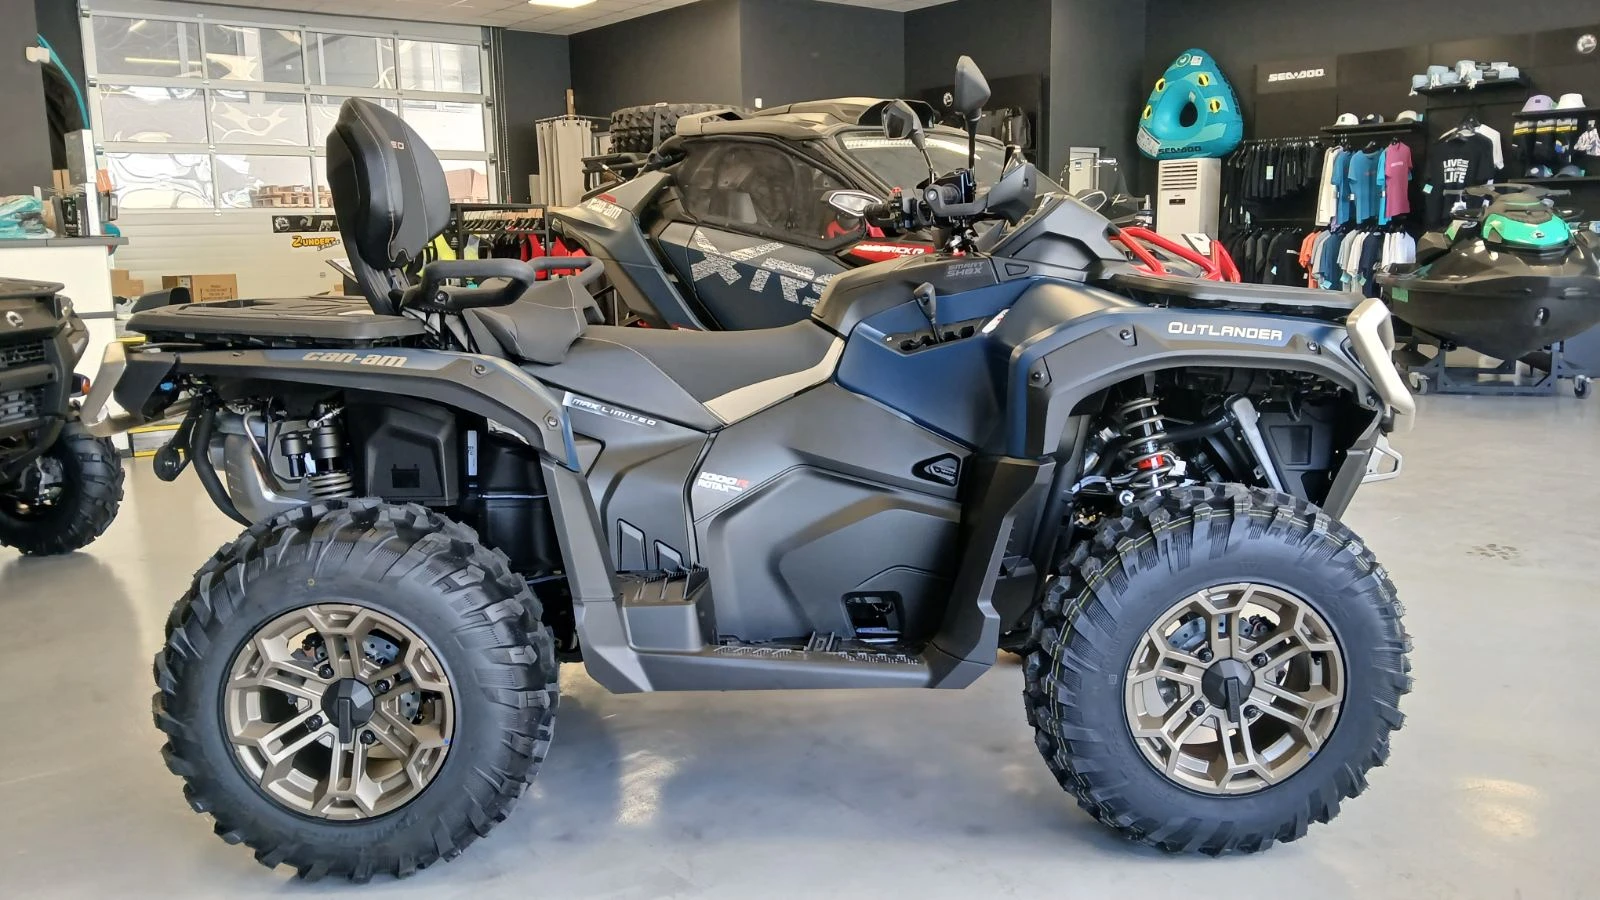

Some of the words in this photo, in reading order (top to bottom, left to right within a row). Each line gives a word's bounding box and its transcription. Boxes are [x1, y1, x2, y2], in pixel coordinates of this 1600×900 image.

[1444, 171, 1467, 184] LIFE
[302, 352, 408, 368] can-am
[572, 398, 600, 411] MAX
[601, 406, 657, 426] LIMITED
